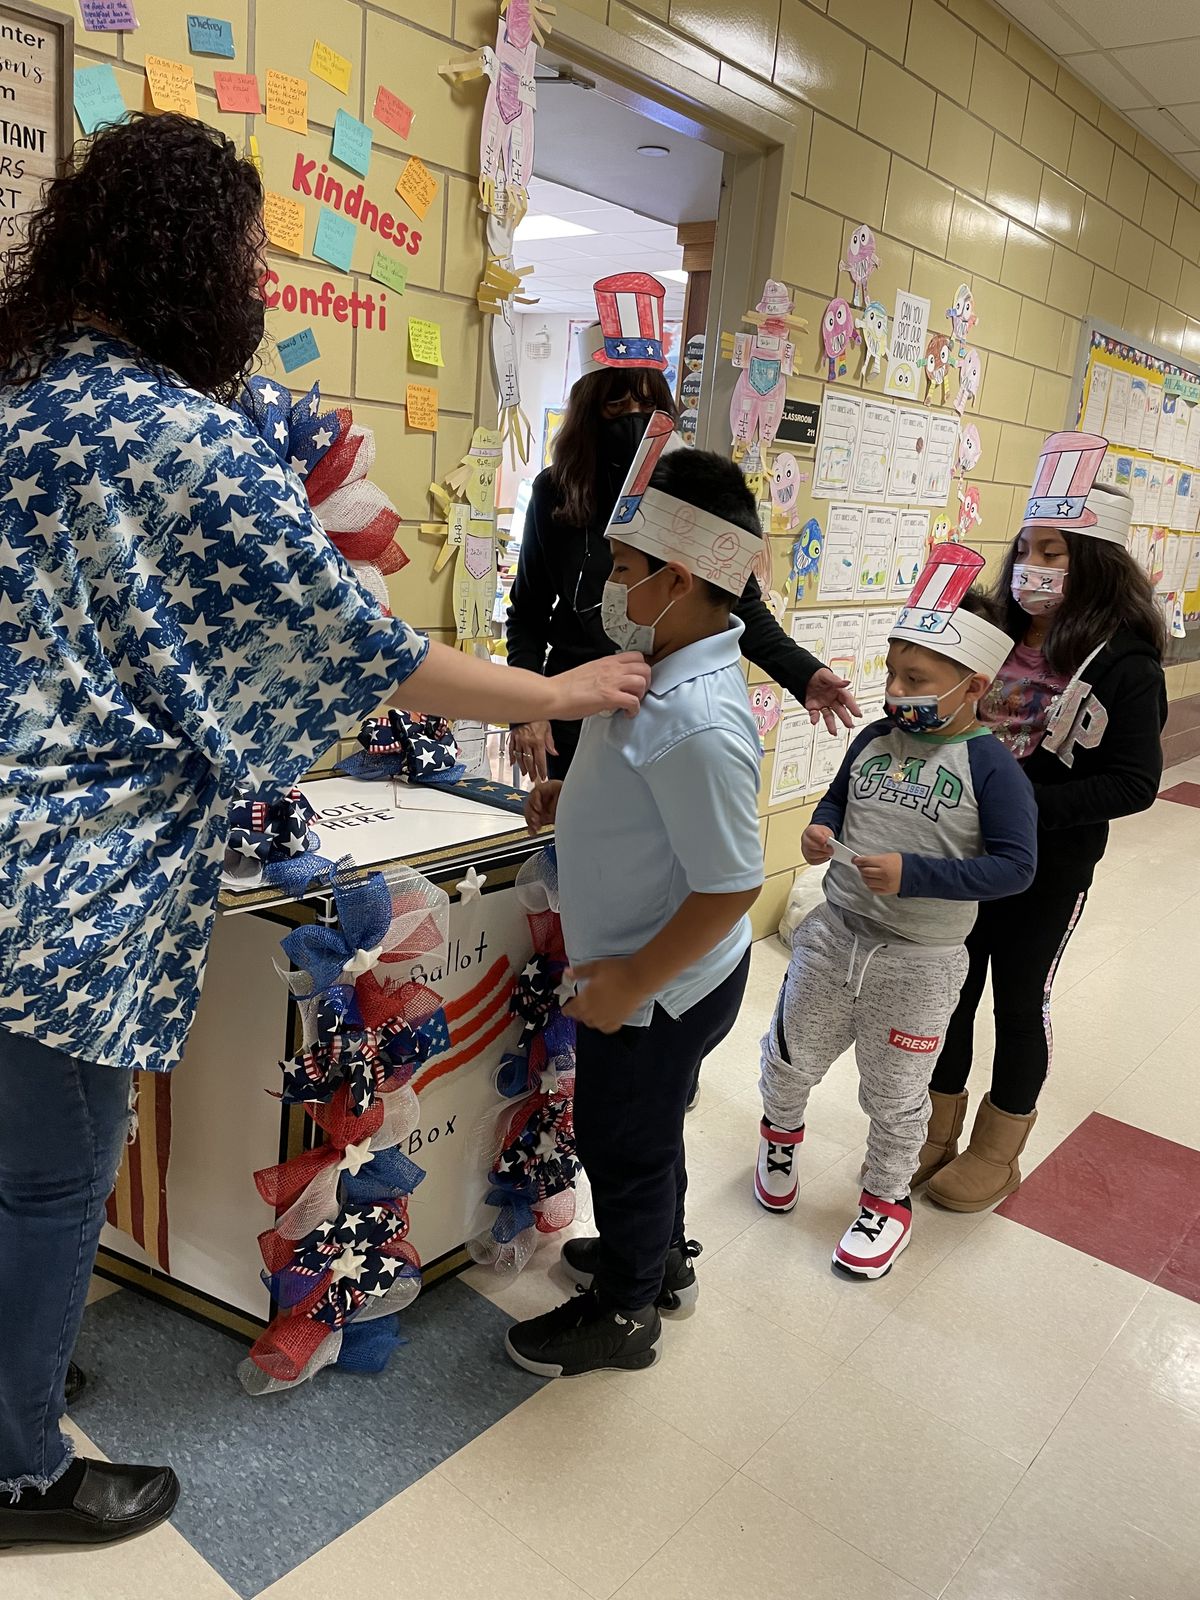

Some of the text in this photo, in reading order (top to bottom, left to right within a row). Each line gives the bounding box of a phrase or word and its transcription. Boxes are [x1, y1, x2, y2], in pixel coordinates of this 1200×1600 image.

[292, 152, 424, 256] Kindness
[258, 269, 387, 332] Confetti
[901, 301, 924, 325] CAN YOU
[897, 321, 910, 341] SPOT
[781, 411, 813, 425] CLASSROOM
[806, 428, 816, 438] 211
[854, 753, 964, 823] GAP
[905, 785, 926, 795] 1969
[316, 802, 373, 820] OTE
[321, 812, 395, 831] HERE
[410, 931, 488, 986] Ballot
[893, 1033, 937, 1051] FRESH
[408, 1115, 457, 1156] Box
